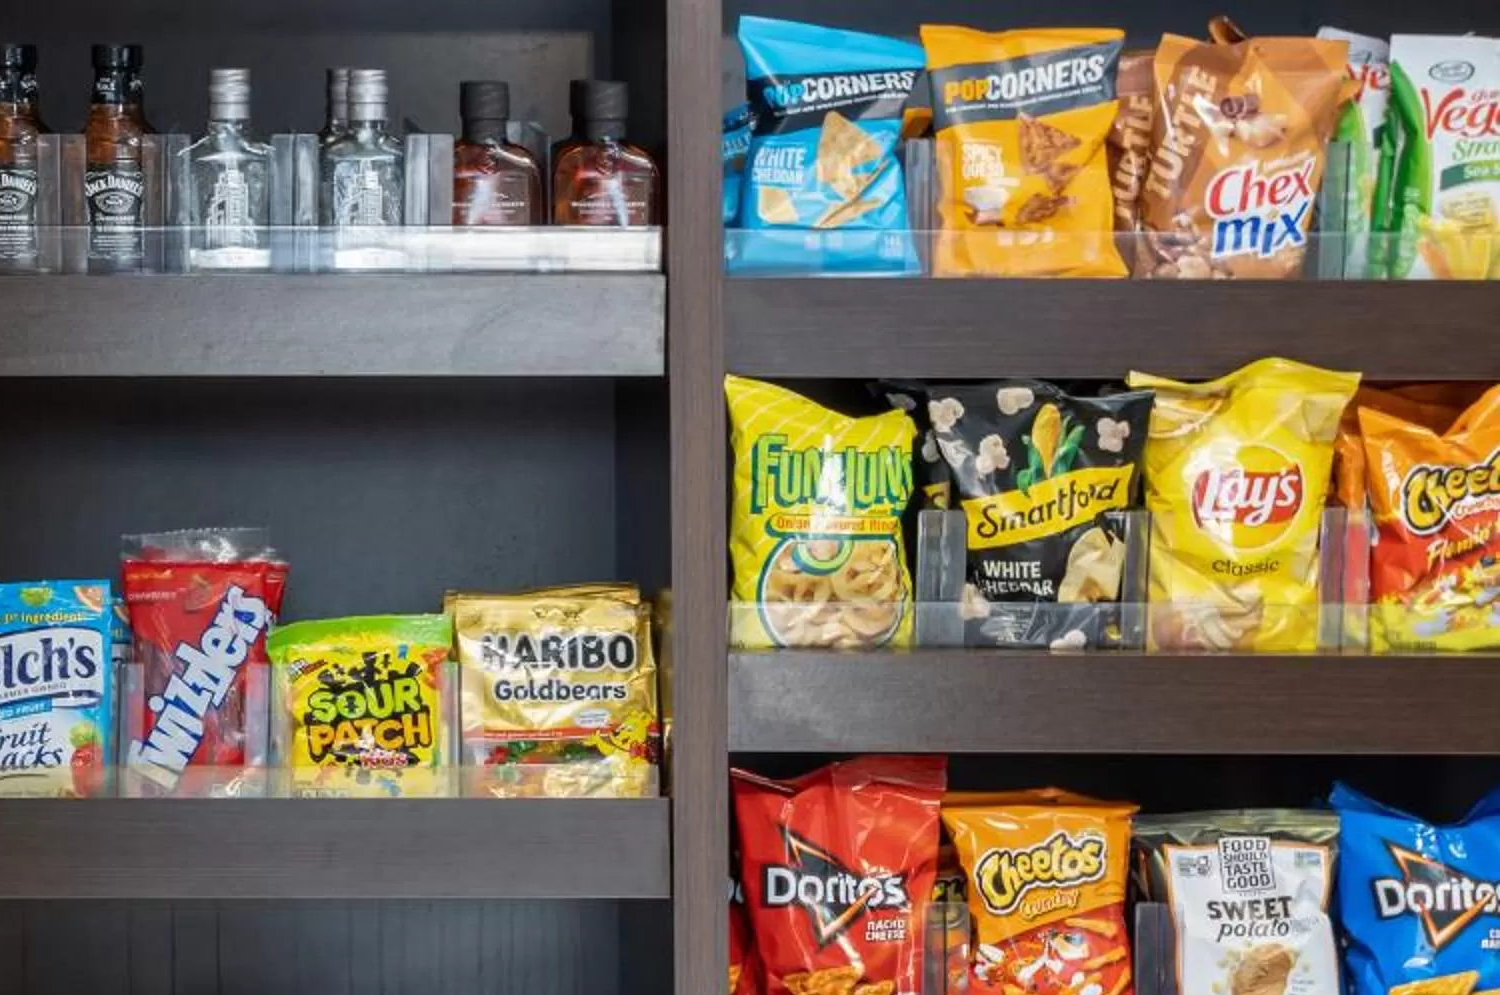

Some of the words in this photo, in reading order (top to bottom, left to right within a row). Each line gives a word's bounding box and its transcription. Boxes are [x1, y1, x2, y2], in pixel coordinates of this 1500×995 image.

[1421, 88, 1500, 141] Veg
[753, 146, 807, 168] WHITE
[84, 179, 106, 197] JACK
[1209, 160, 1313, 216] Chex
[1214, 200, 1309, 255] mix
[1196, 460, 1300, 526] Lay's
[1405, 455, 1500, 531] Chee
[983, 560, 1042, 579] WHITE
[1210, 557, 1281, 579] Classic
[482, 634, 635, 670] HARIBO
[309, 676, 422, 724] SOUR
[494, 679, 627, 701] Goldbears
[308, 711, 433, 757] PATCH
[1221, 839, 1268, 853] FOOD
[1223, 852, 1268, 863] SHOULD
[977, 833, 1105, 910] Cheetos
[1225, 862, 1269, 876] TASTE
[767, 867, 908, 907] Doritos
[1226, 875, 1271, 889] GOOD
[1206, 896, 1293, 920] SWEET
[867, 919, 906, 932] NACHO
[1215, 919, 1291, 944] potato
